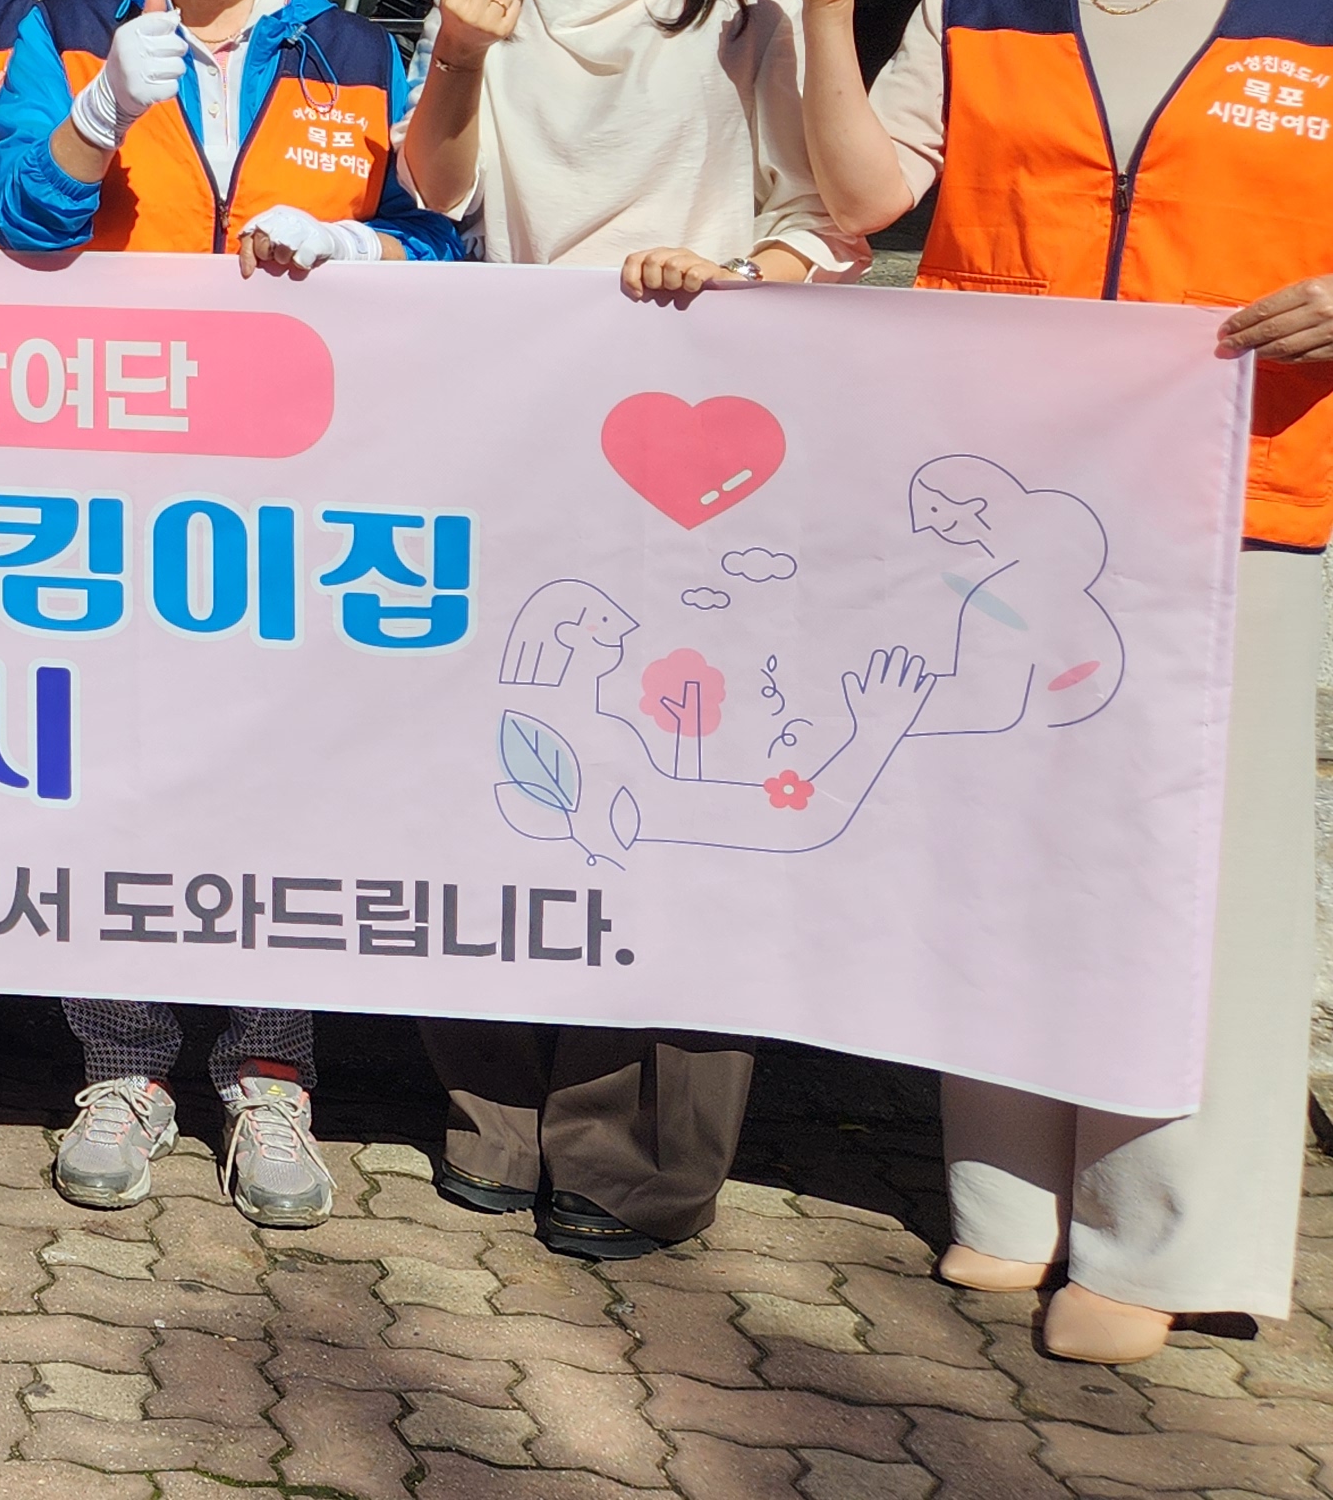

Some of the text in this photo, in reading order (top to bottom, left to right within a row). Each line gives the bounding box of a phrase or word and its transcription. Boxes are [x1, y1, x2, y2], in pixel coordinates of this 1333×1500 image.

[1226, 55, 1330, 88] 여성친화도시
[1207, 100, 1330, 140] 시민참여단
[285, 146, 371, 179] 시민참여단
[99, 866, 637, 968] 도와드립니다.
